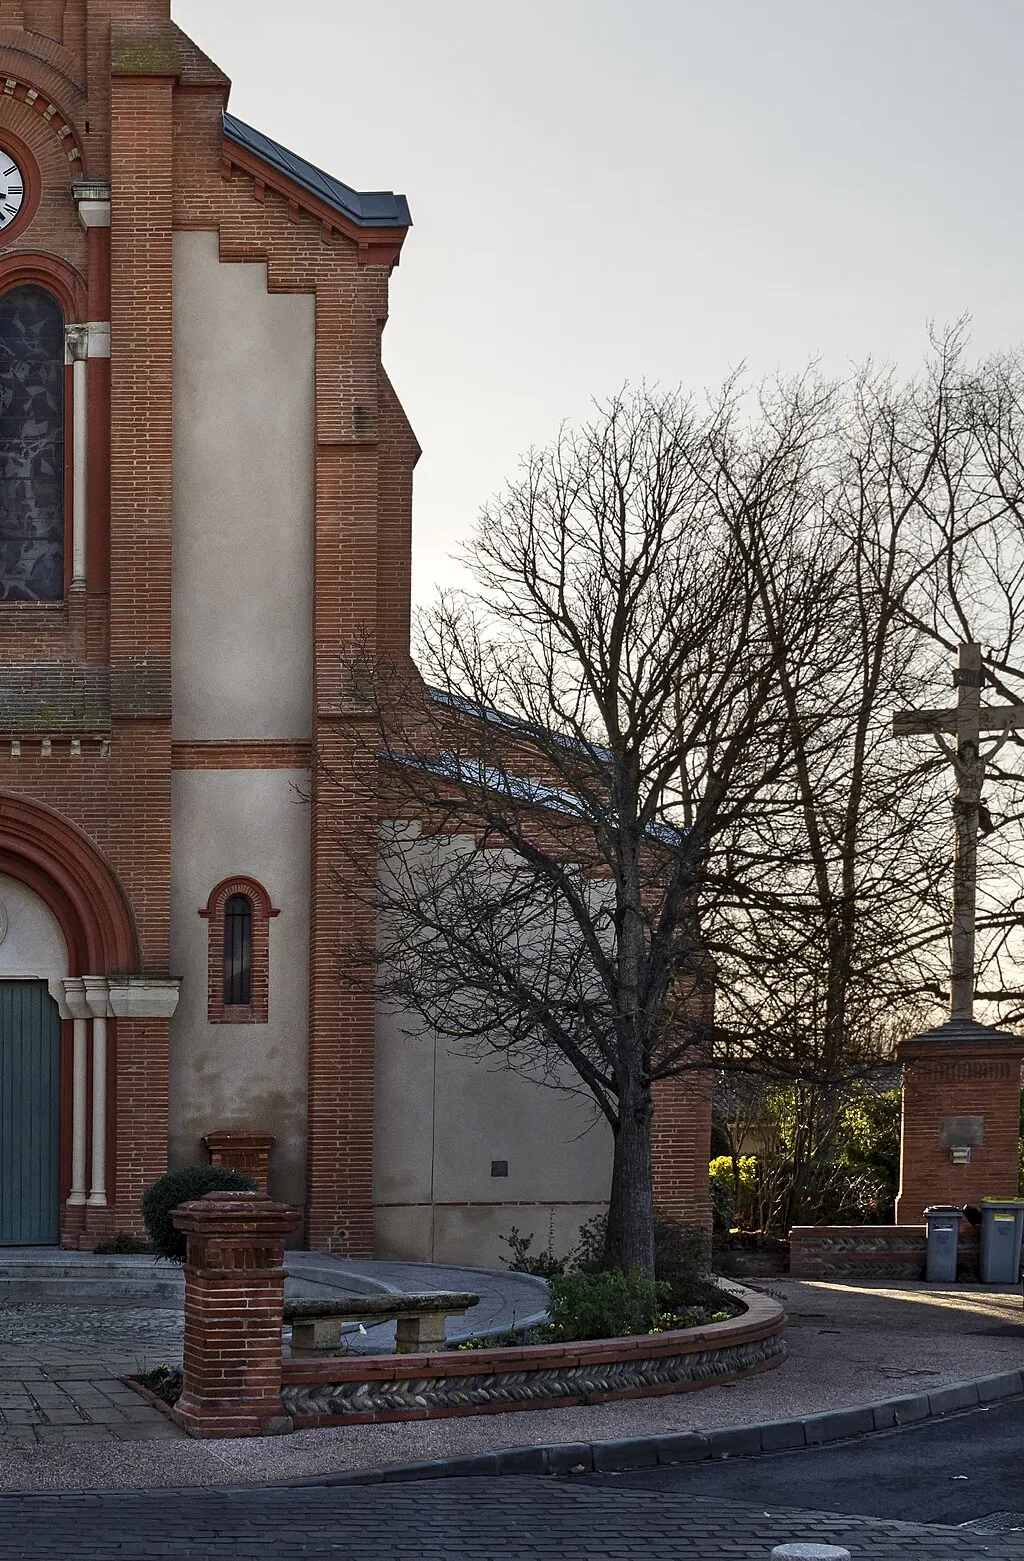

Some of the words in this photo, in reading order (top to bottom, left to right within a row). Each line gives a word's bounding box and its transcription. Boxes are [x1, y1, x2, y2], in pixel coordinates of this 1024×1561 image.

[3, 166, 17, 177] II
[8, 186, 22, 194] III
[3, 203, 18, 216] IV
